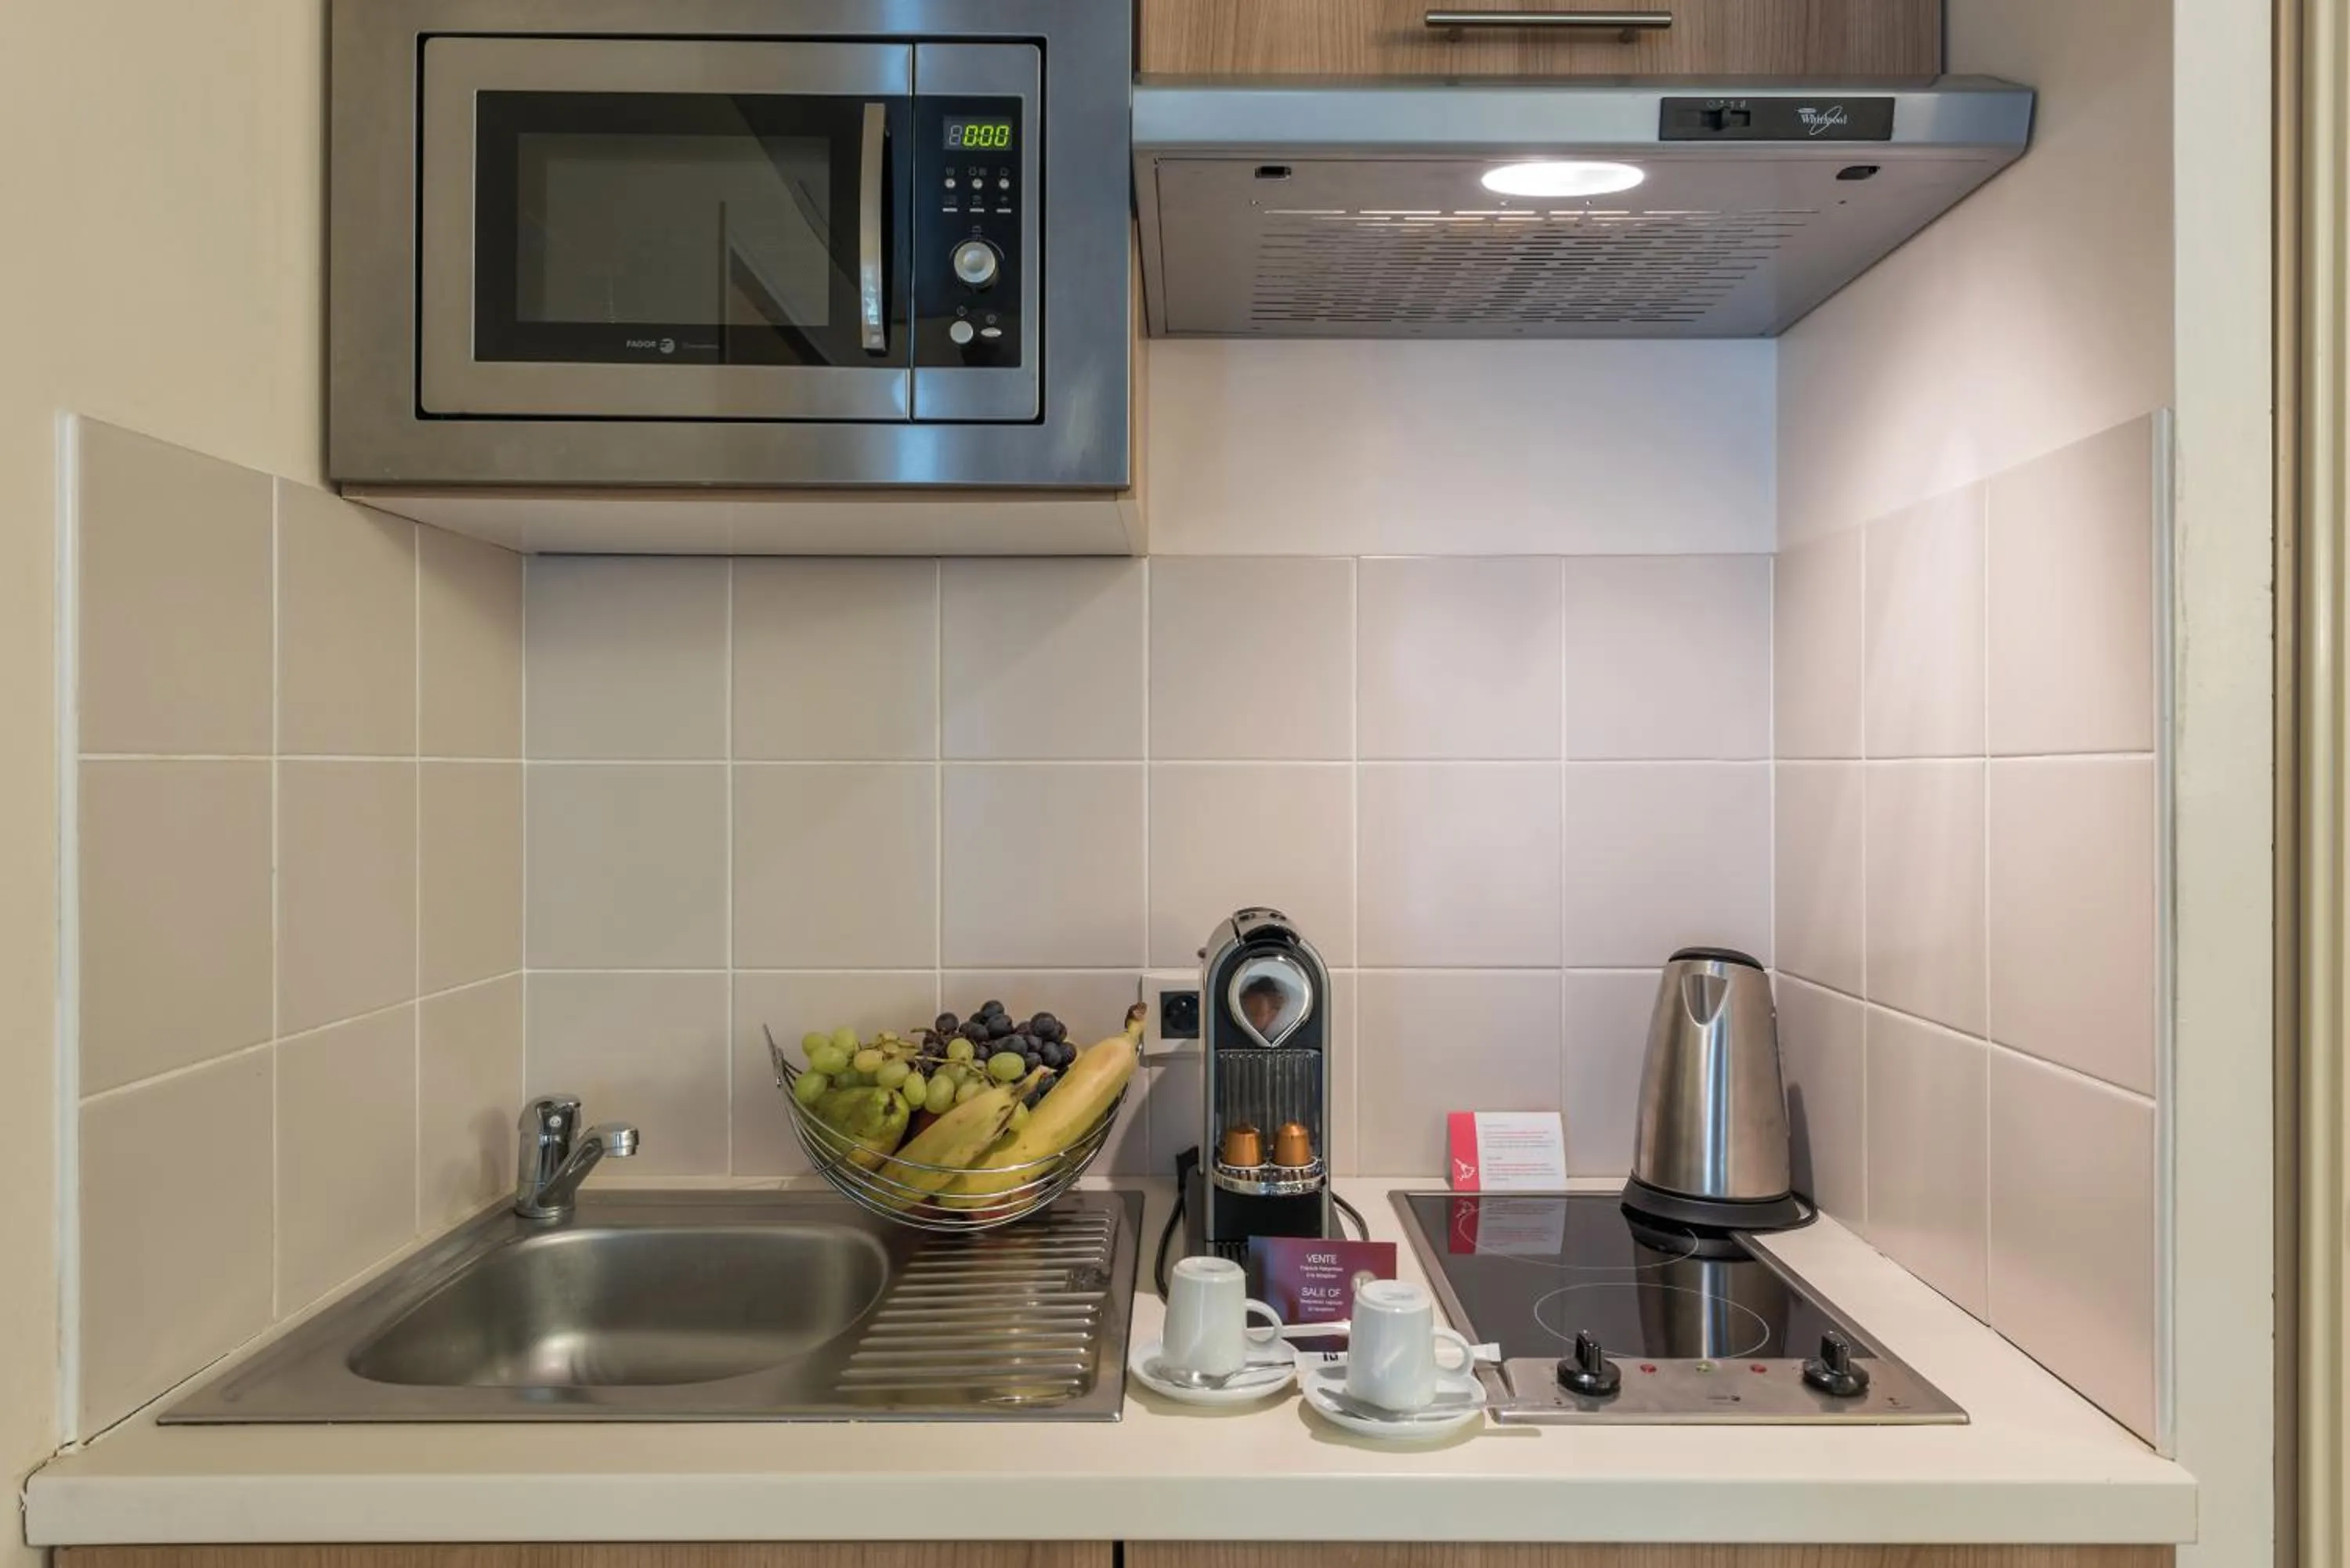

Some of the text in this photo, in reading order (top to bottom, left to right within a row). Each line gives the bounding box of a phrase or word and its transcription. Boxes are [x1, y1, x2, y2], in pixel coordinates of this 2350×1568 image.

[1306, 1253, 1337, 1264] VENTE
[1301, 1287, 1342, 1298] SALE OF
